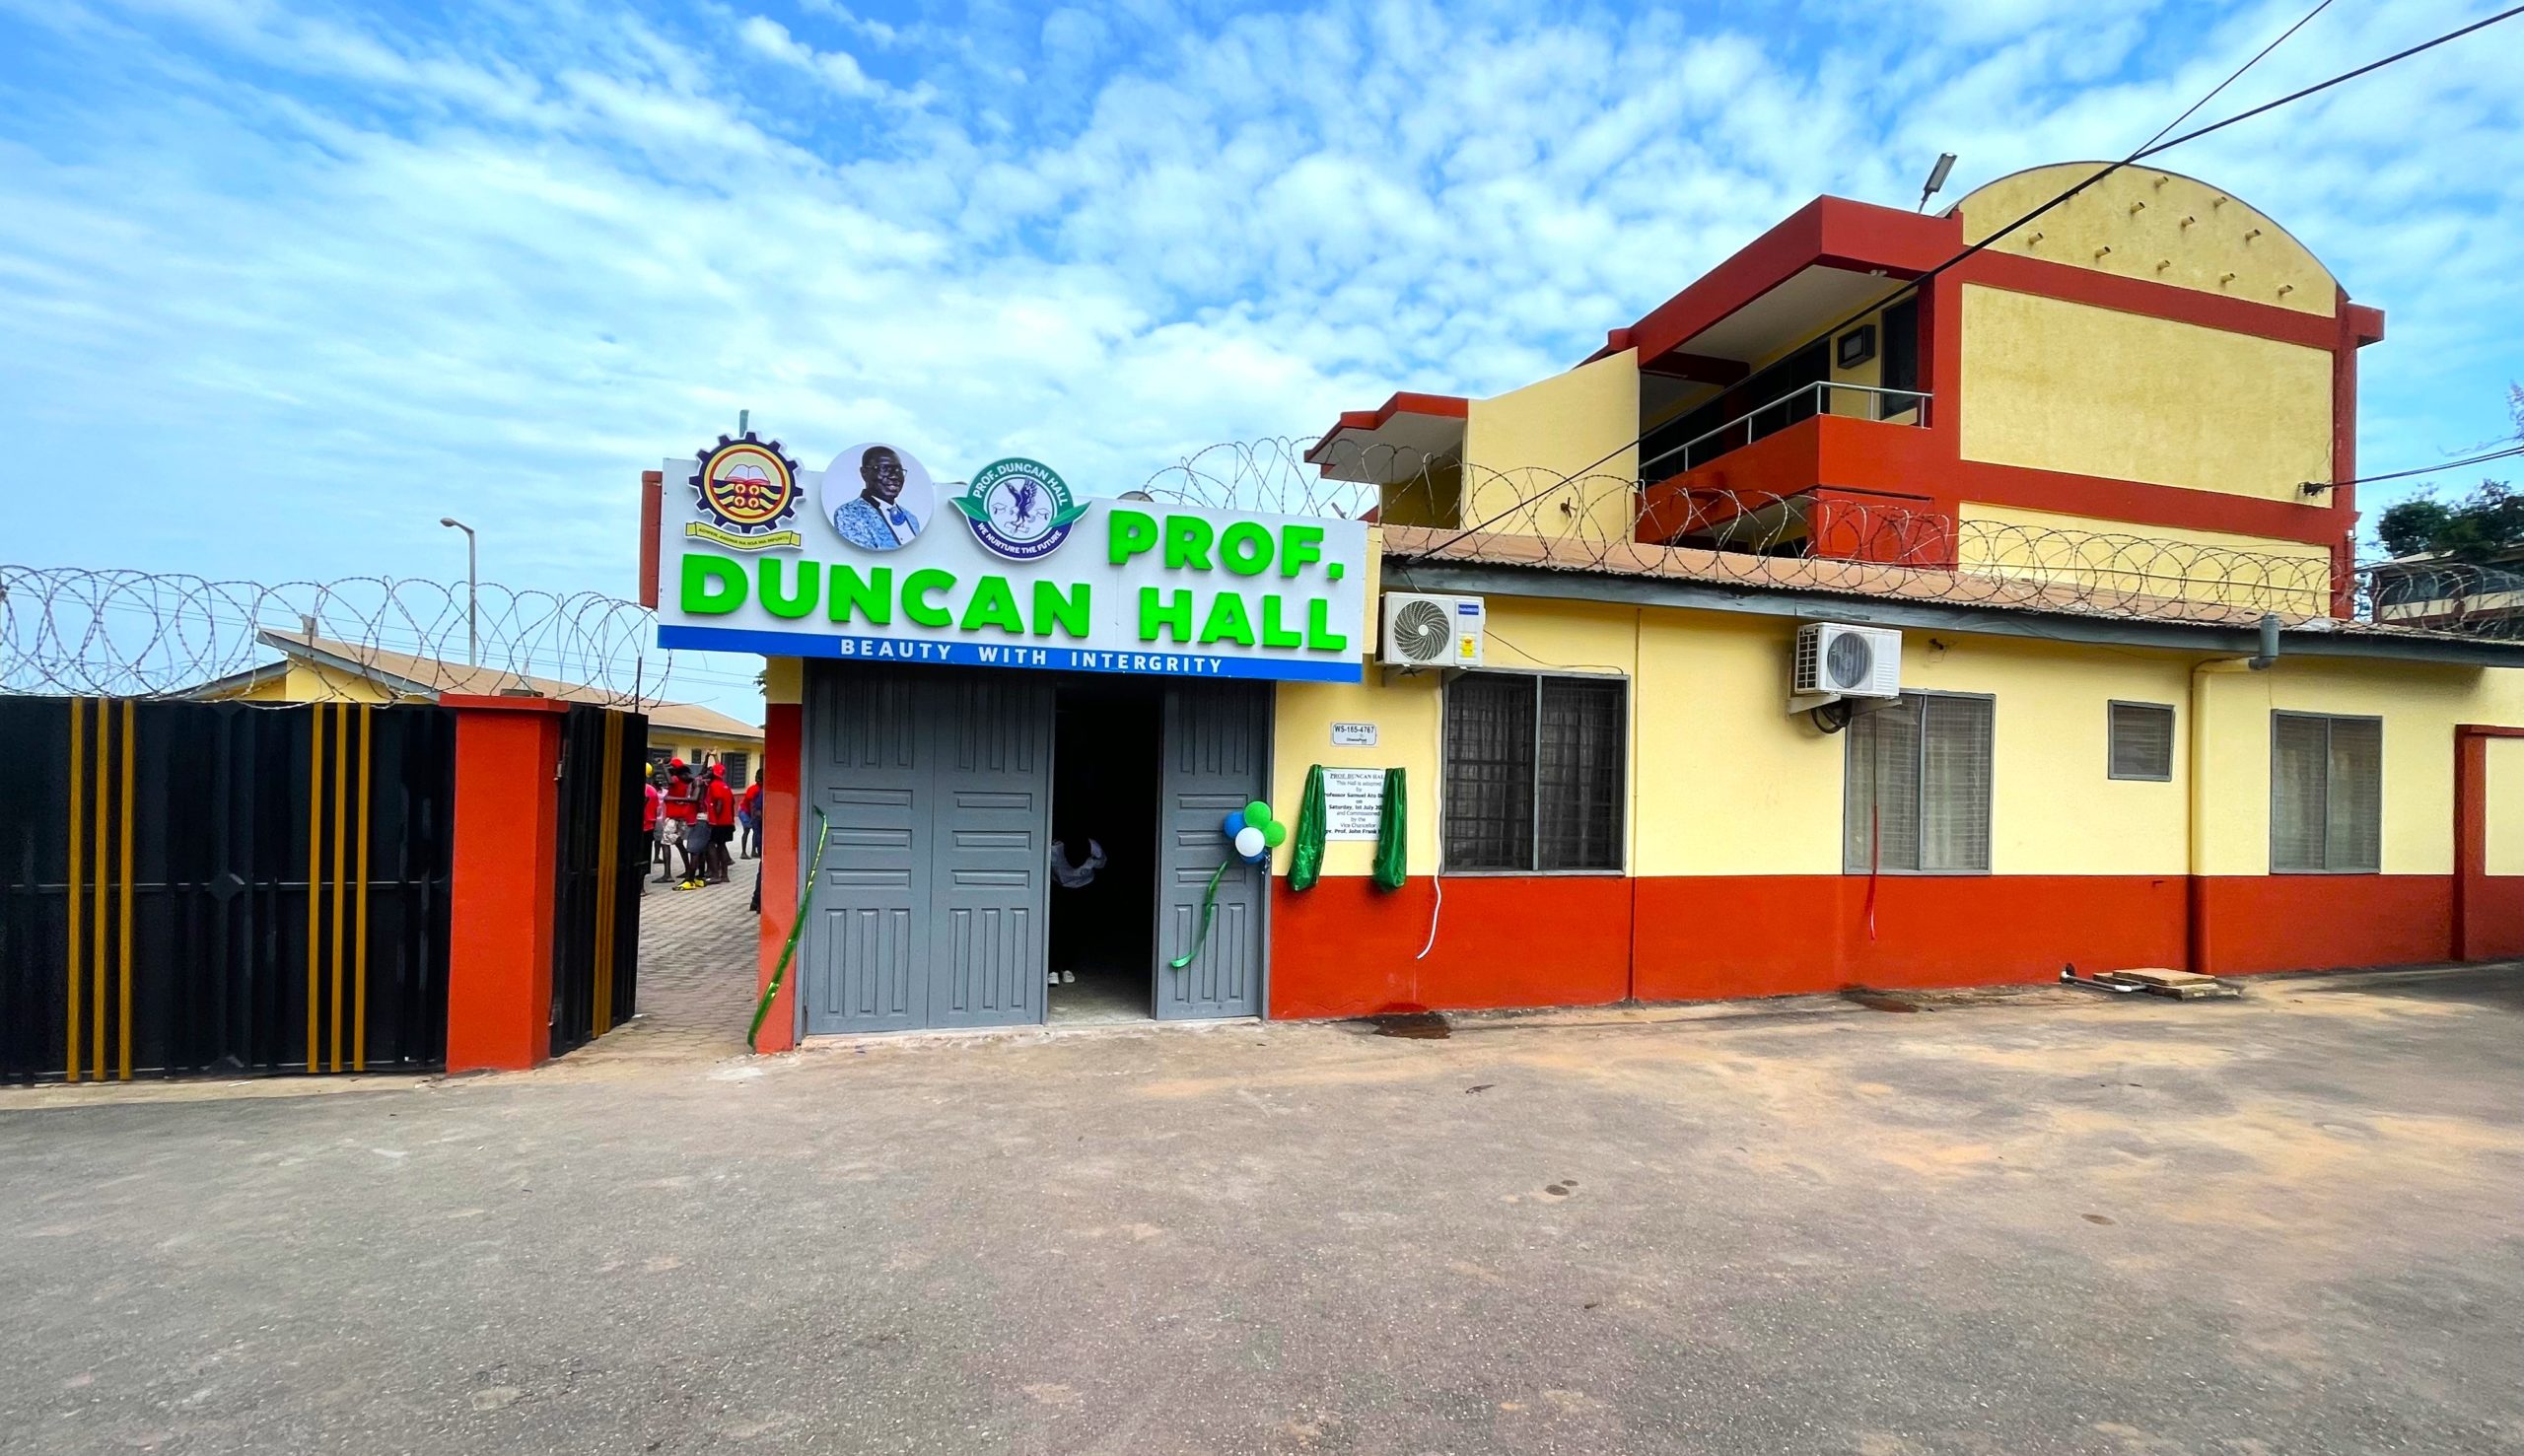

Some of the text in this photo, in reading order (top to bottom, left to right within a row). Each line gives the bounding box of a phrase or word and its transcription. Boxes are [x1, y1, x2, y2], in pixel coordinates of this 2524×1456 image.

[973, 462, 1068, 507] PROF. DUNCAN HALL
[977, 522, 987, 536] WE
[986, 531, 1020, 554] NURTURE
[1037, 529, 1063, 552] FUTURE
[1108, 510, 1344, 580] PROF.
[681, 554, 1348, 652] DUNCAN HALL
[840, 639, 1223, 673] BEAUTY WITH INTERGRITY
